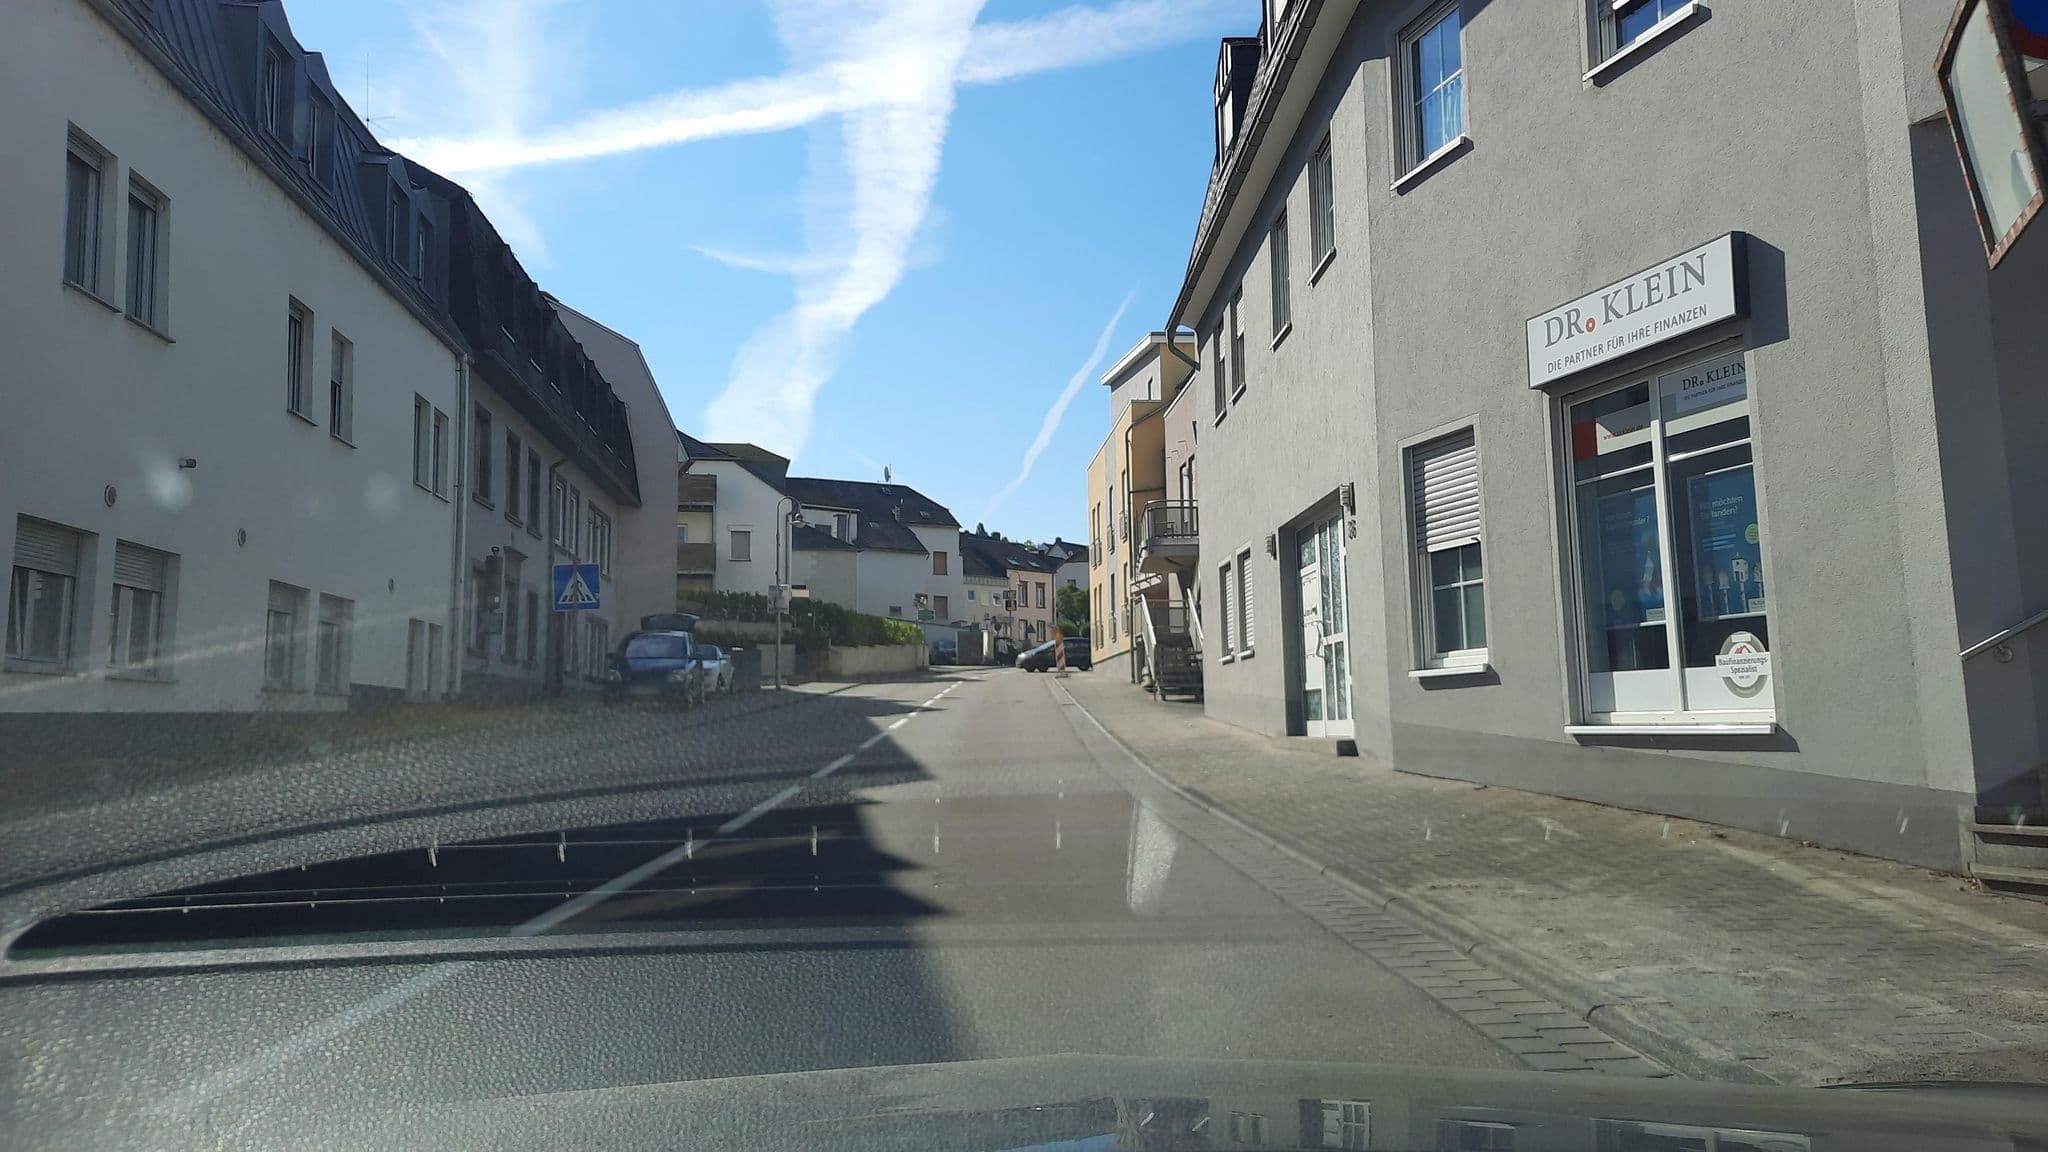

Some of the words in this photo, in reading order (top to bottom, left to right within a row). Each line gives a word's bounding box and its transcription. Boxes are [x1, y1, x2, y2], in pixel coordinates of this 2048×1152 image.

[1600, 252, 1707, 326] KLEIN
[1547, 358, 1562, 374] DIE
[1564, 343, 1604, 368] PARTNER
[1606, 335, 1625, 352] FÜR
[1627, 325, 1651, 345] IHRE
[1654, 303, 1707, 335] FINANZEN
[1706, 361, 1746, 384] KLEIN
